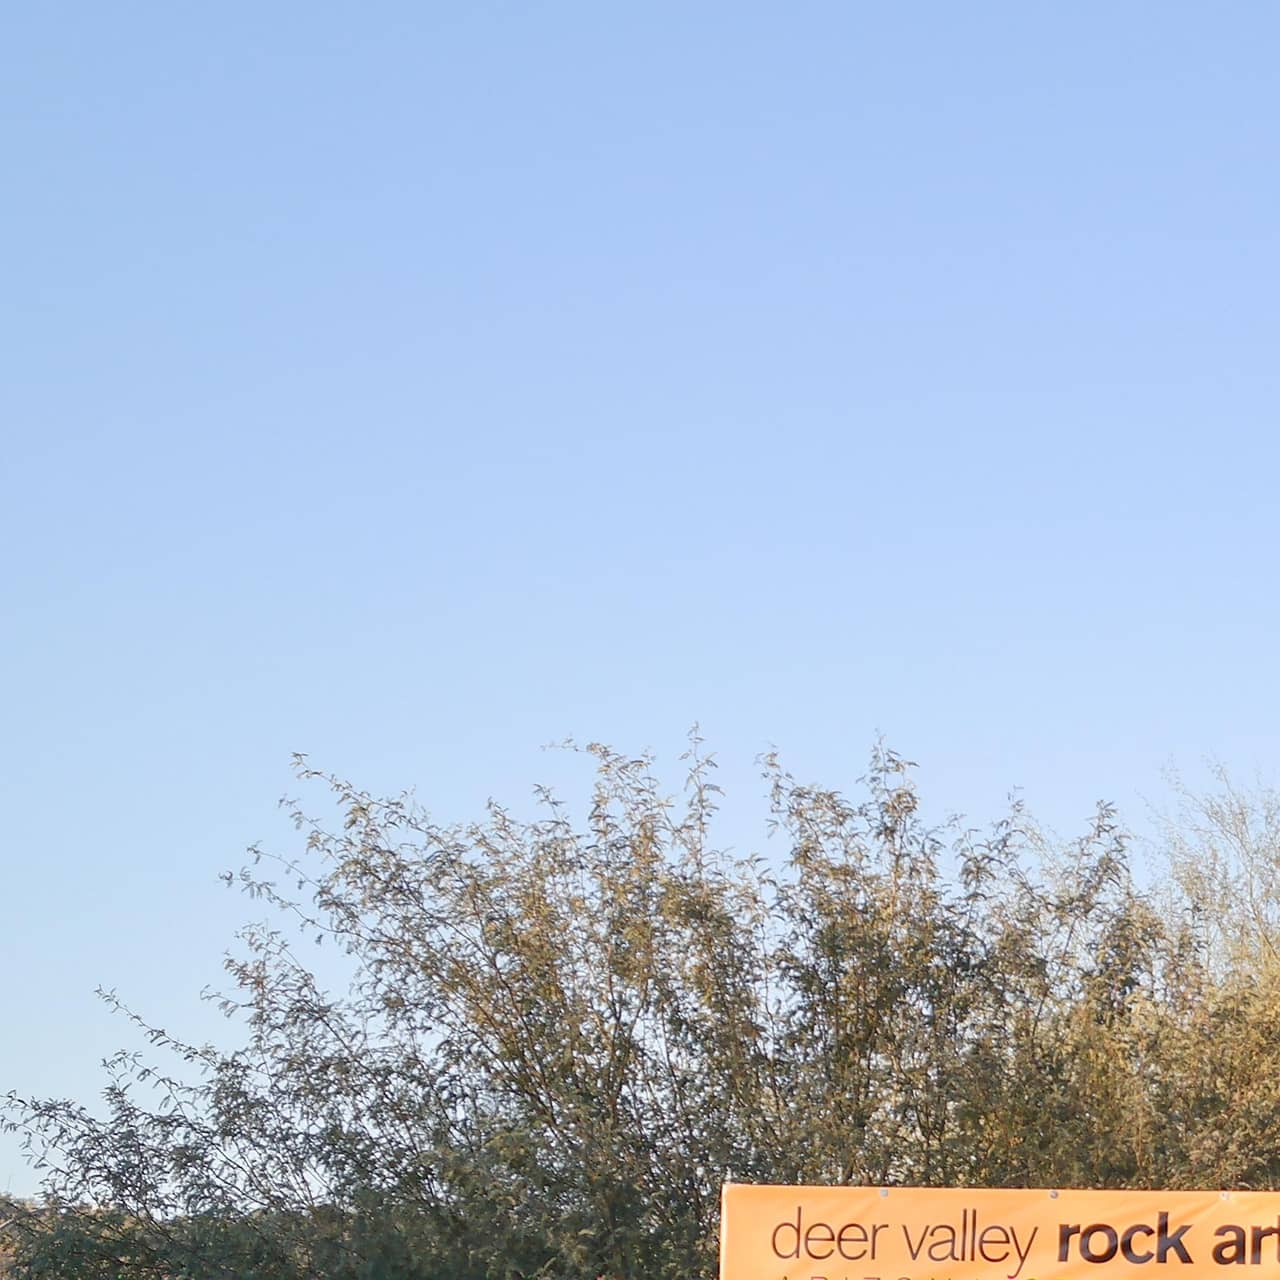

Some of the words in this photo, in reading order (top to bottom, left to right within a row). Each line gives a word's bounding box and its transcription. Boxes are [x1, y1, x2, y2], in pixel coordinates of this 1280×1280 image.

[772, 1206, 889, 1260] deer
[902, 1208, 1038, 1279] valley
[1058, 1212, 1194, 1264] rock
